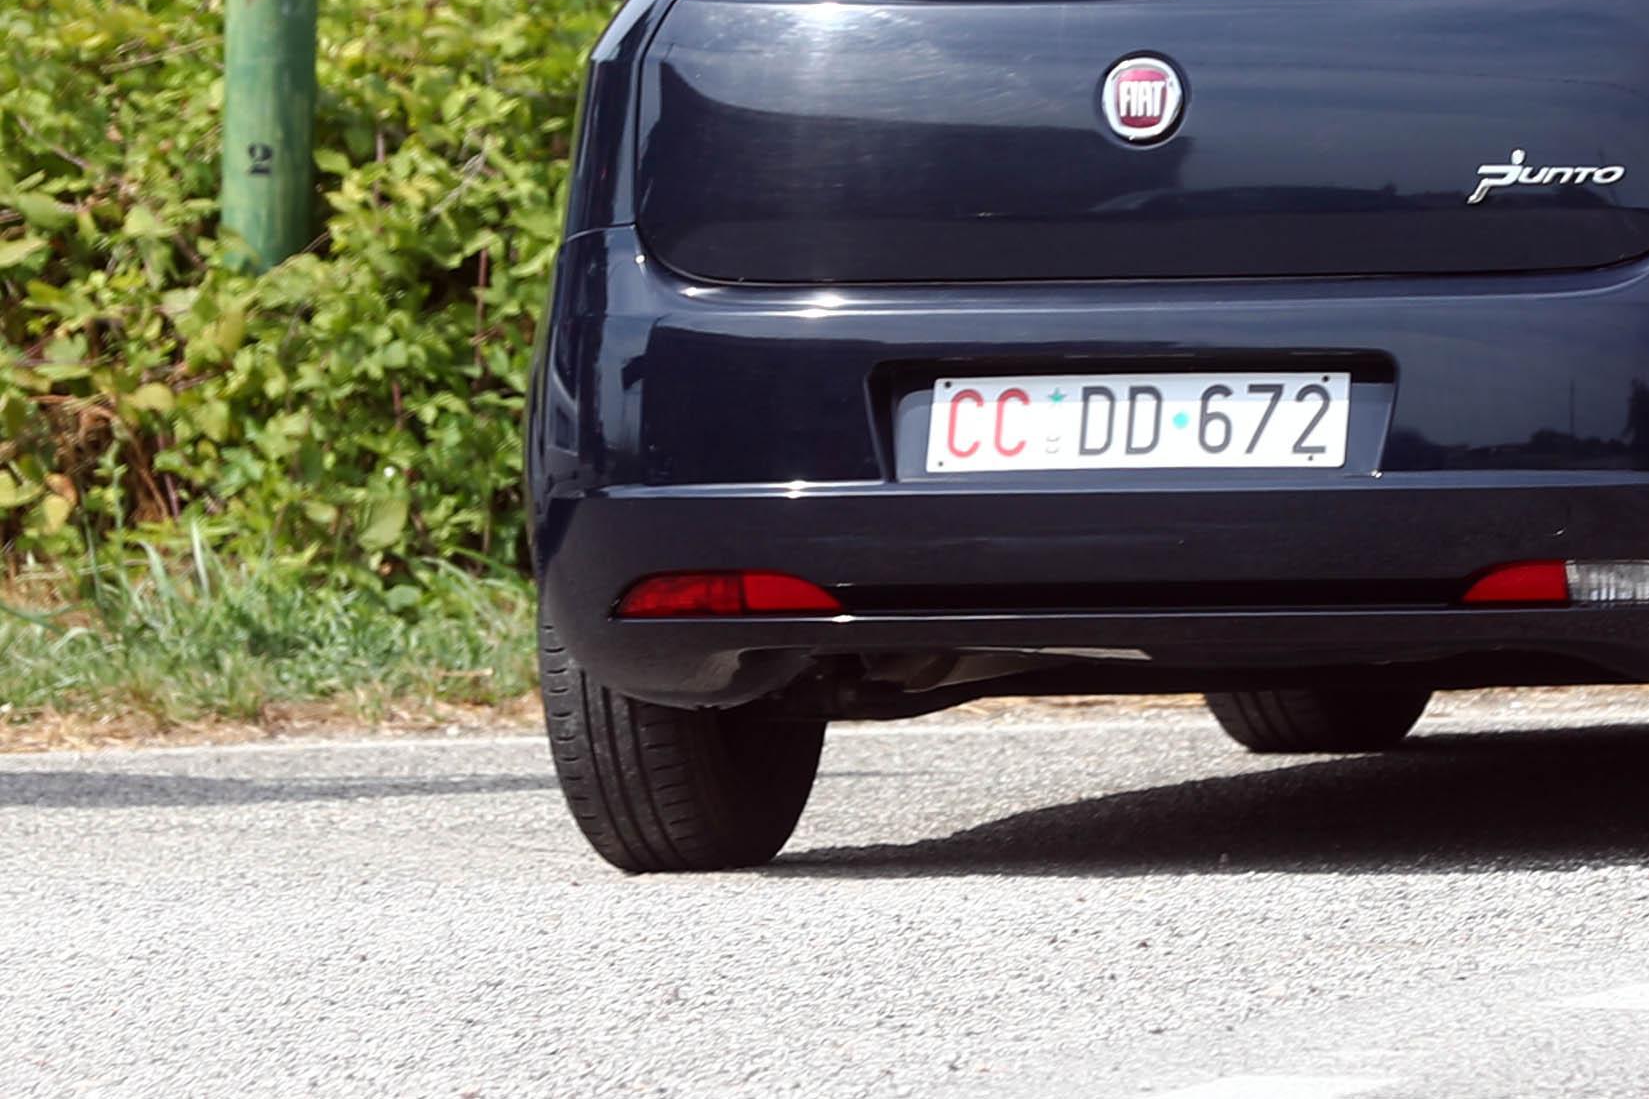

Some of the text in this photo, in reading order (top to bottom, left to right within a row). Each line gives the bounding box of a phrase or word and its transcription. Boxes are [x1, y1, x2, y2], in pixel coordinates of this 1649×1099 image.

[1118, 80, 1166, 117] FIAT
[946, 383, 1332, 458] CC DD 672
